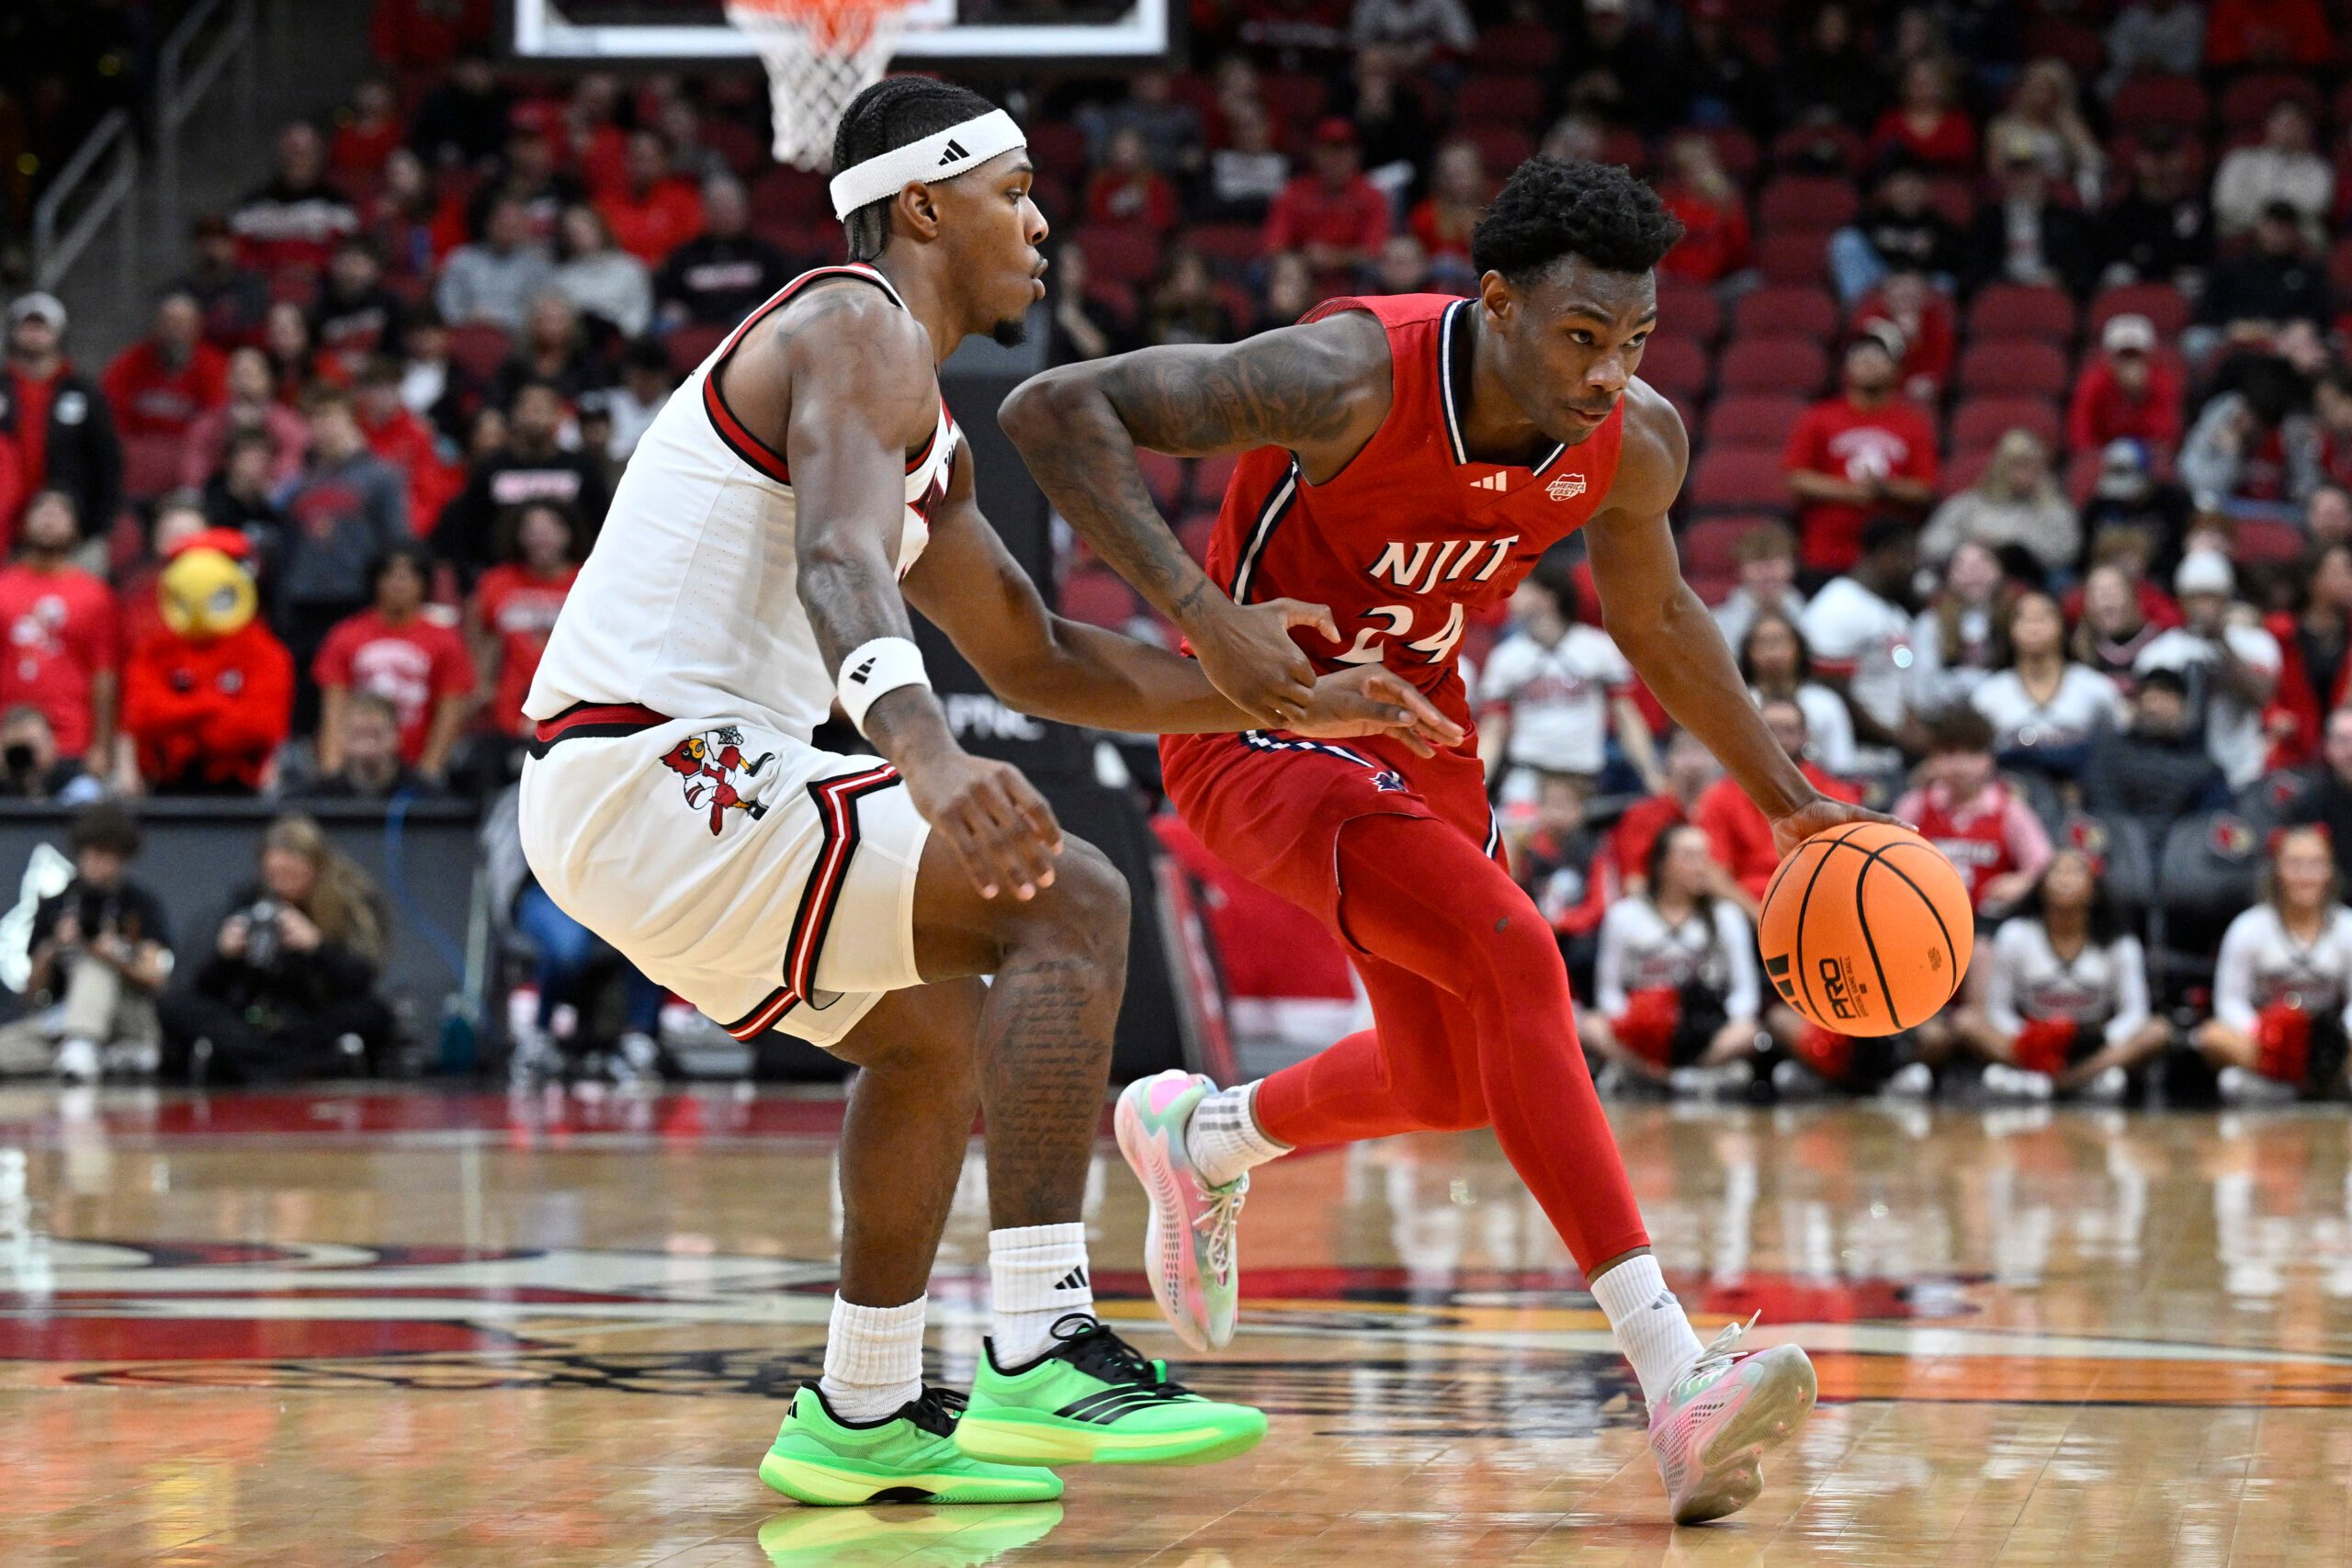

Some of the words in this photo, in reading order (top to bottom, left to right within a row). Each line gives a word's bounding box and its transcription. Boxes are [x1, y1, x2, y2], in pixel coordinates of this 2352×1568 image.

[1548, 481, 1585, 491] AMERICA
[1368, 535, 1520, 594] NJIT
[1332, 603, 1464, 664] 24
[1819, 958, 1856, 1019] PRO
